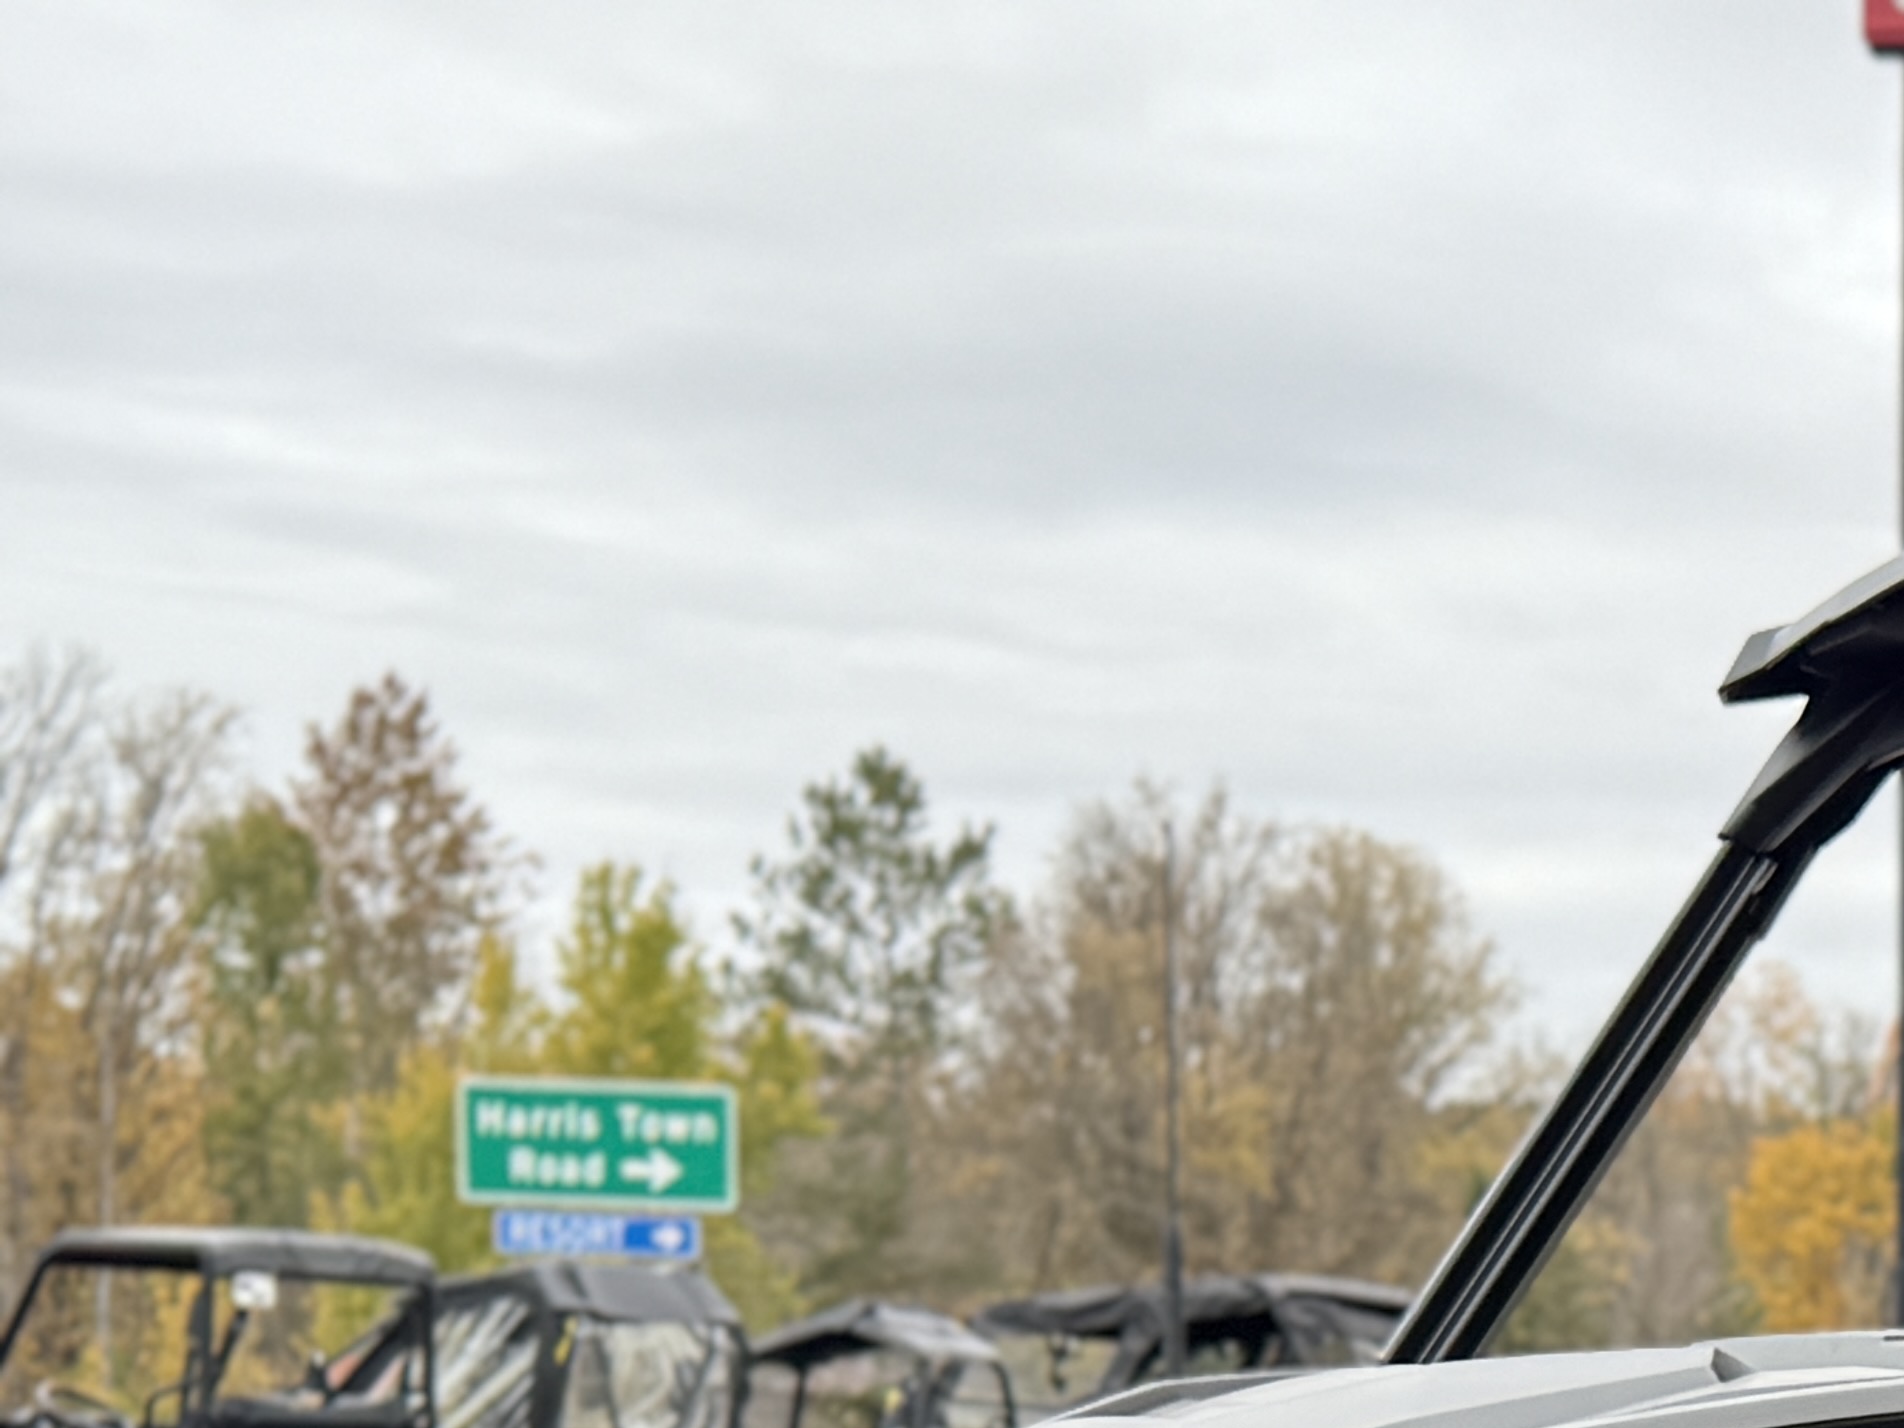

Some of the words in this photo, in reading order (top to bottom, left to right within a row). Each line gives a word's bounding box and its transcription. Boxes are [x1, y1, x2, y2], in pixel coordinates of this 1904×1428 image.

[474, 1100, 601, 1141] Harris
[616, 1102, 719, 1144] Town
[507, 1145, 607, 1187] Road
